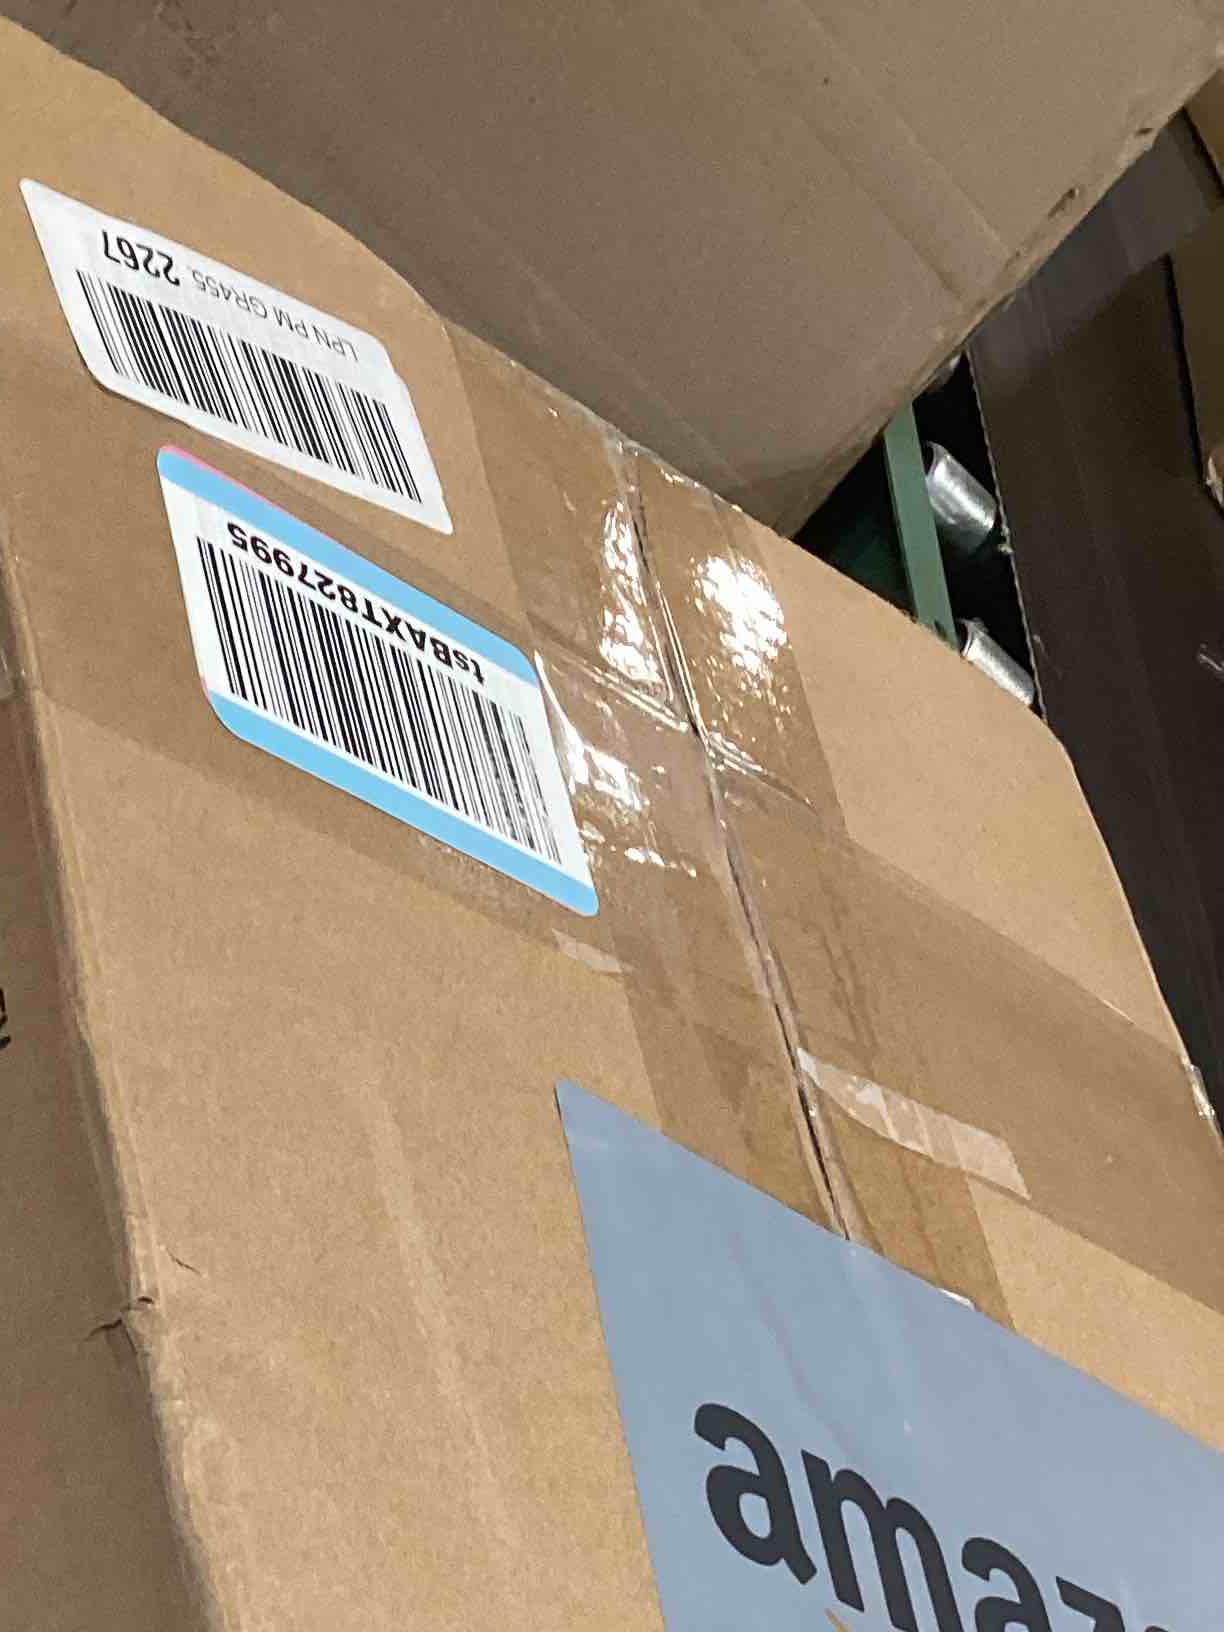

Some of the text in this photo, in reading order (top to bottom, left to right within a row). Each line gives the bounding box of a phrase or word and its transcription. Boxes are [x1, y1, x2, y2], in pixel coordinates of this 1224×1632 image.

[101, 228, 181, 287] 2267
[272, 305, 309, 338] PM
[312, 323, 359, 363] LPN
[227, 521, 485, 686] tsBAXT827995
